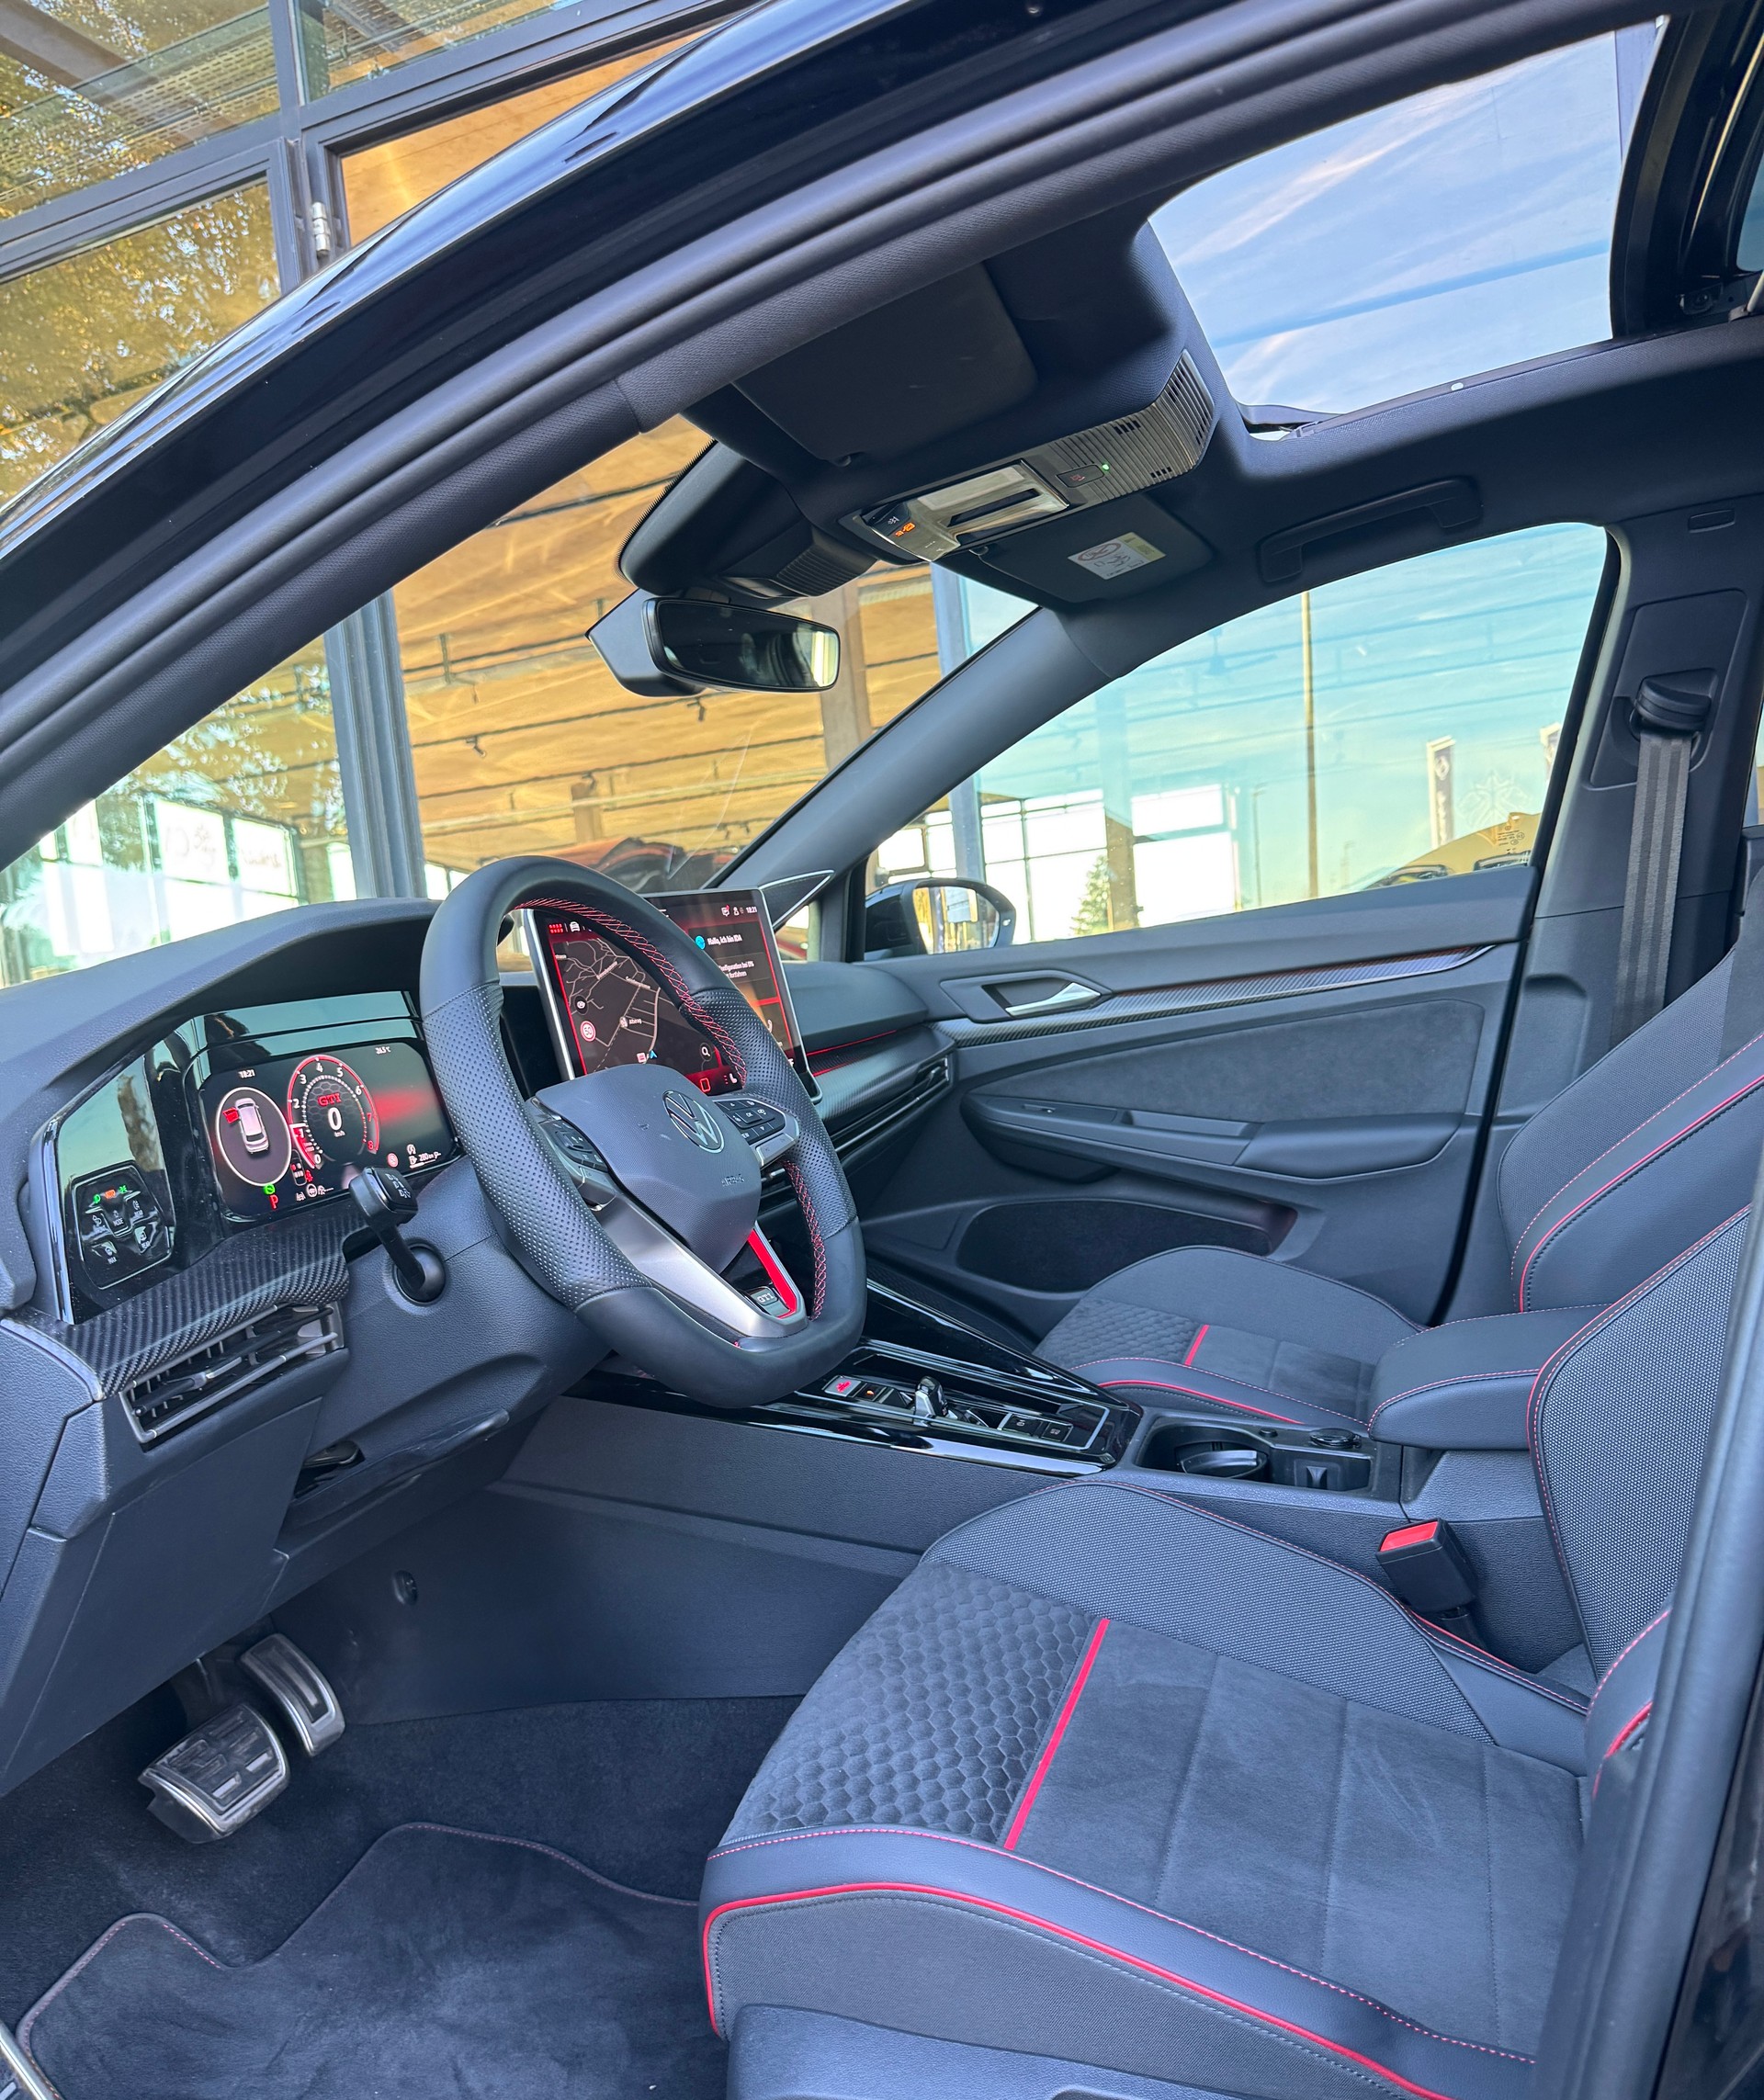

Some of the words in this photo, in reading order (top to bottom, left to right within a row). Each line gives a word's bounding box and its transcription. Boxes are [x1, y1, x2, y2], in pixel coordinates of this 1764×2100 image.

[315, 1062, 323, 1073] 4
[336, 1067, 344, 1078] 5
[300, 1074, 307, 1085] 3
[355, 1085, 363, 1096] 6
[292, 1098, 300, 1109] 2
[317, 1092, 342, 1107] GTI
[327, 1106, 343, 1131] 0
[368, 1140, 374, 1150] 8
[314, 1154, 322, 1165] 0
[756, 1292, 775, 1303] GTI
